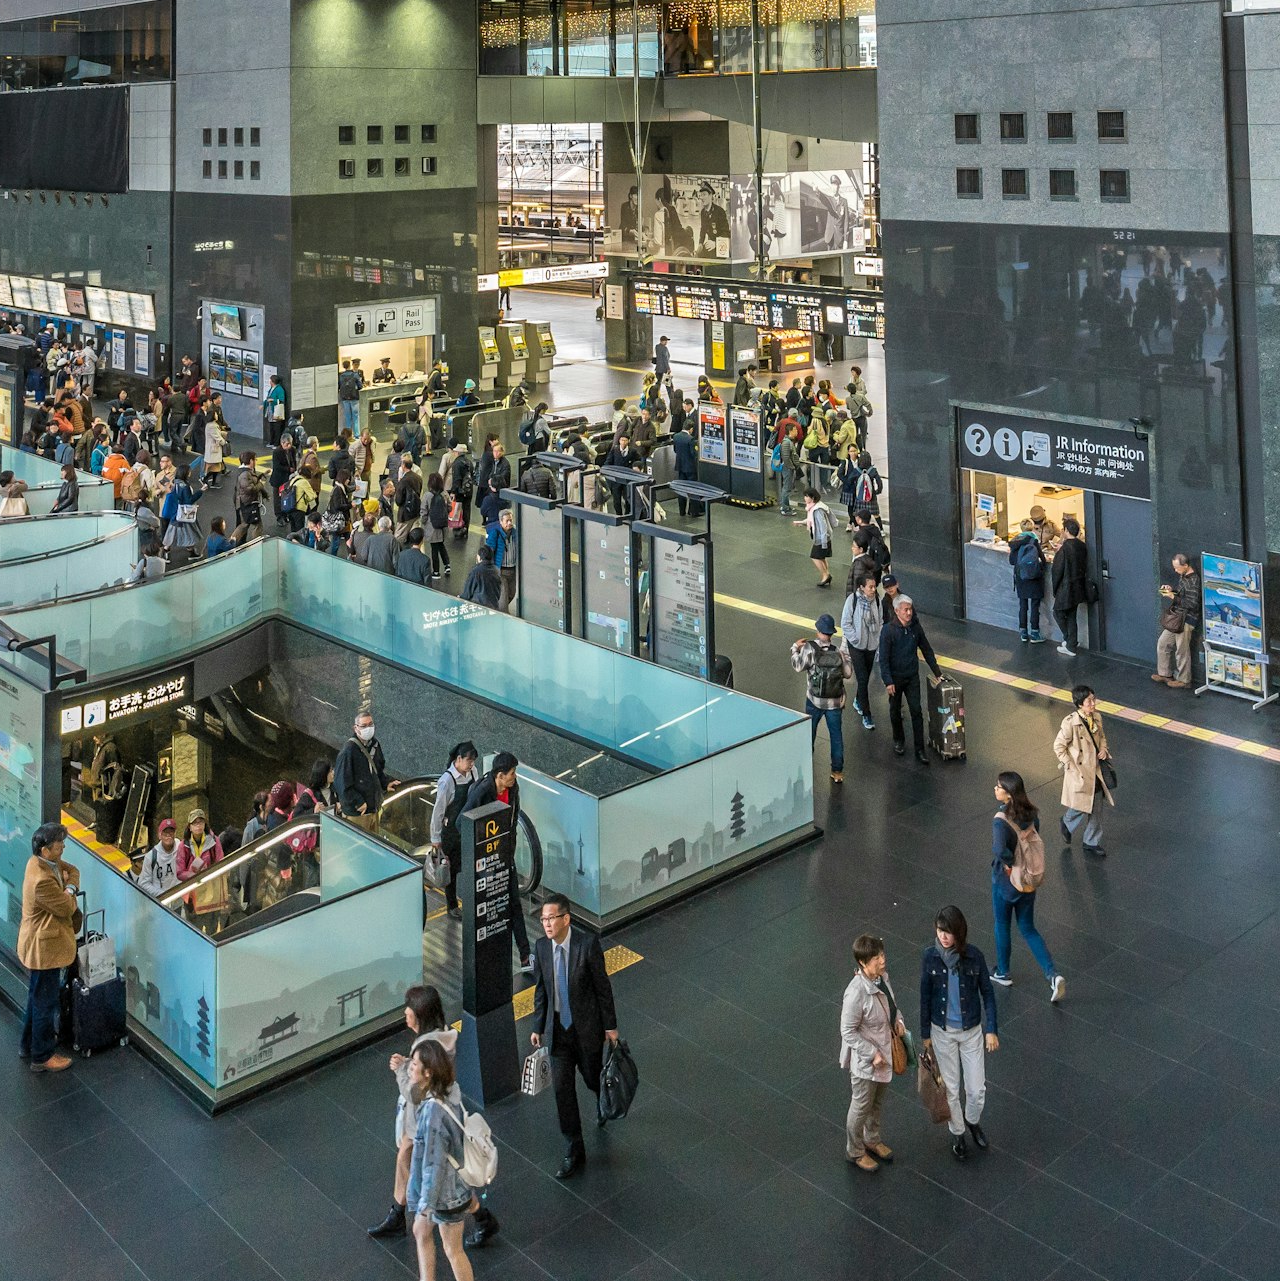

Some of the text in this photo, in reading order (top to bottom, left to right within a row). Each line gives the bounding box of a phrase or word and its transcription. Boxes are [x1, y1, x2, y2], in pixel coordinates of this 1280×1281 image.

[406, 309, 420, 318] Rail
[405, 319, 421, 327] Pass
[1055, 435, 1069, 449] JR
[1071, 437, 1145, 462] Information
[1056, 451, 1091, 465] JR 안내소
[1096, 457, 1106, 466] JR
[108, 676, 185, 711] お手洗・おみやげ
[109, 705, 138, 720] LAVATORY
[142, 697, 169, 710] SOUVENIR
[169, 689, 185, 701] STORE
